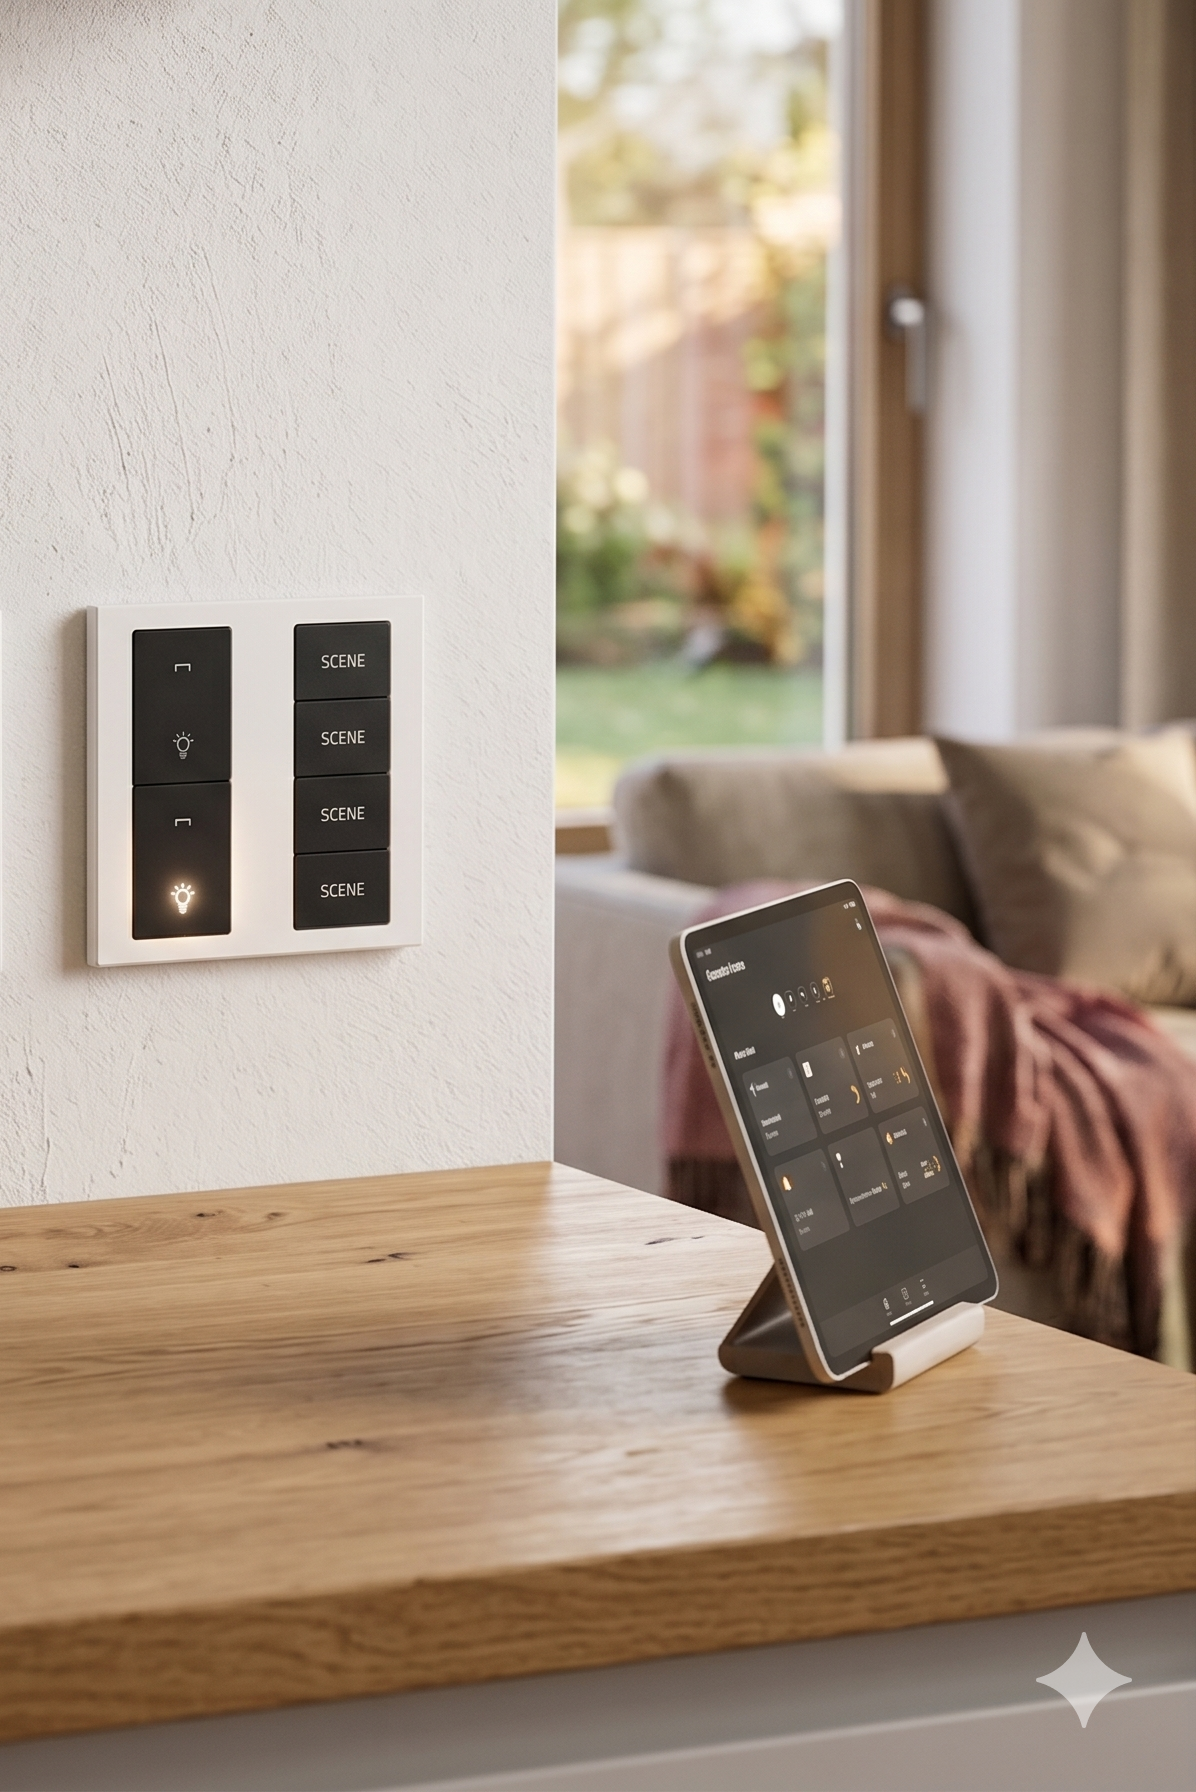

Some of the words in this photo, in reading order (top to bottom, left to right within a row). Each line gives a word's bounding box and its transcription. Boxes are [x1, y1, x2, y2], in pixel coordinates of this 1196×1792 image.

[321, 653, 366, 669] SCENE
[321, 729, 366, 746] SCENE
[320, 806, 366, 822] SCENE
[320, 882, 365, 898] SCENE
